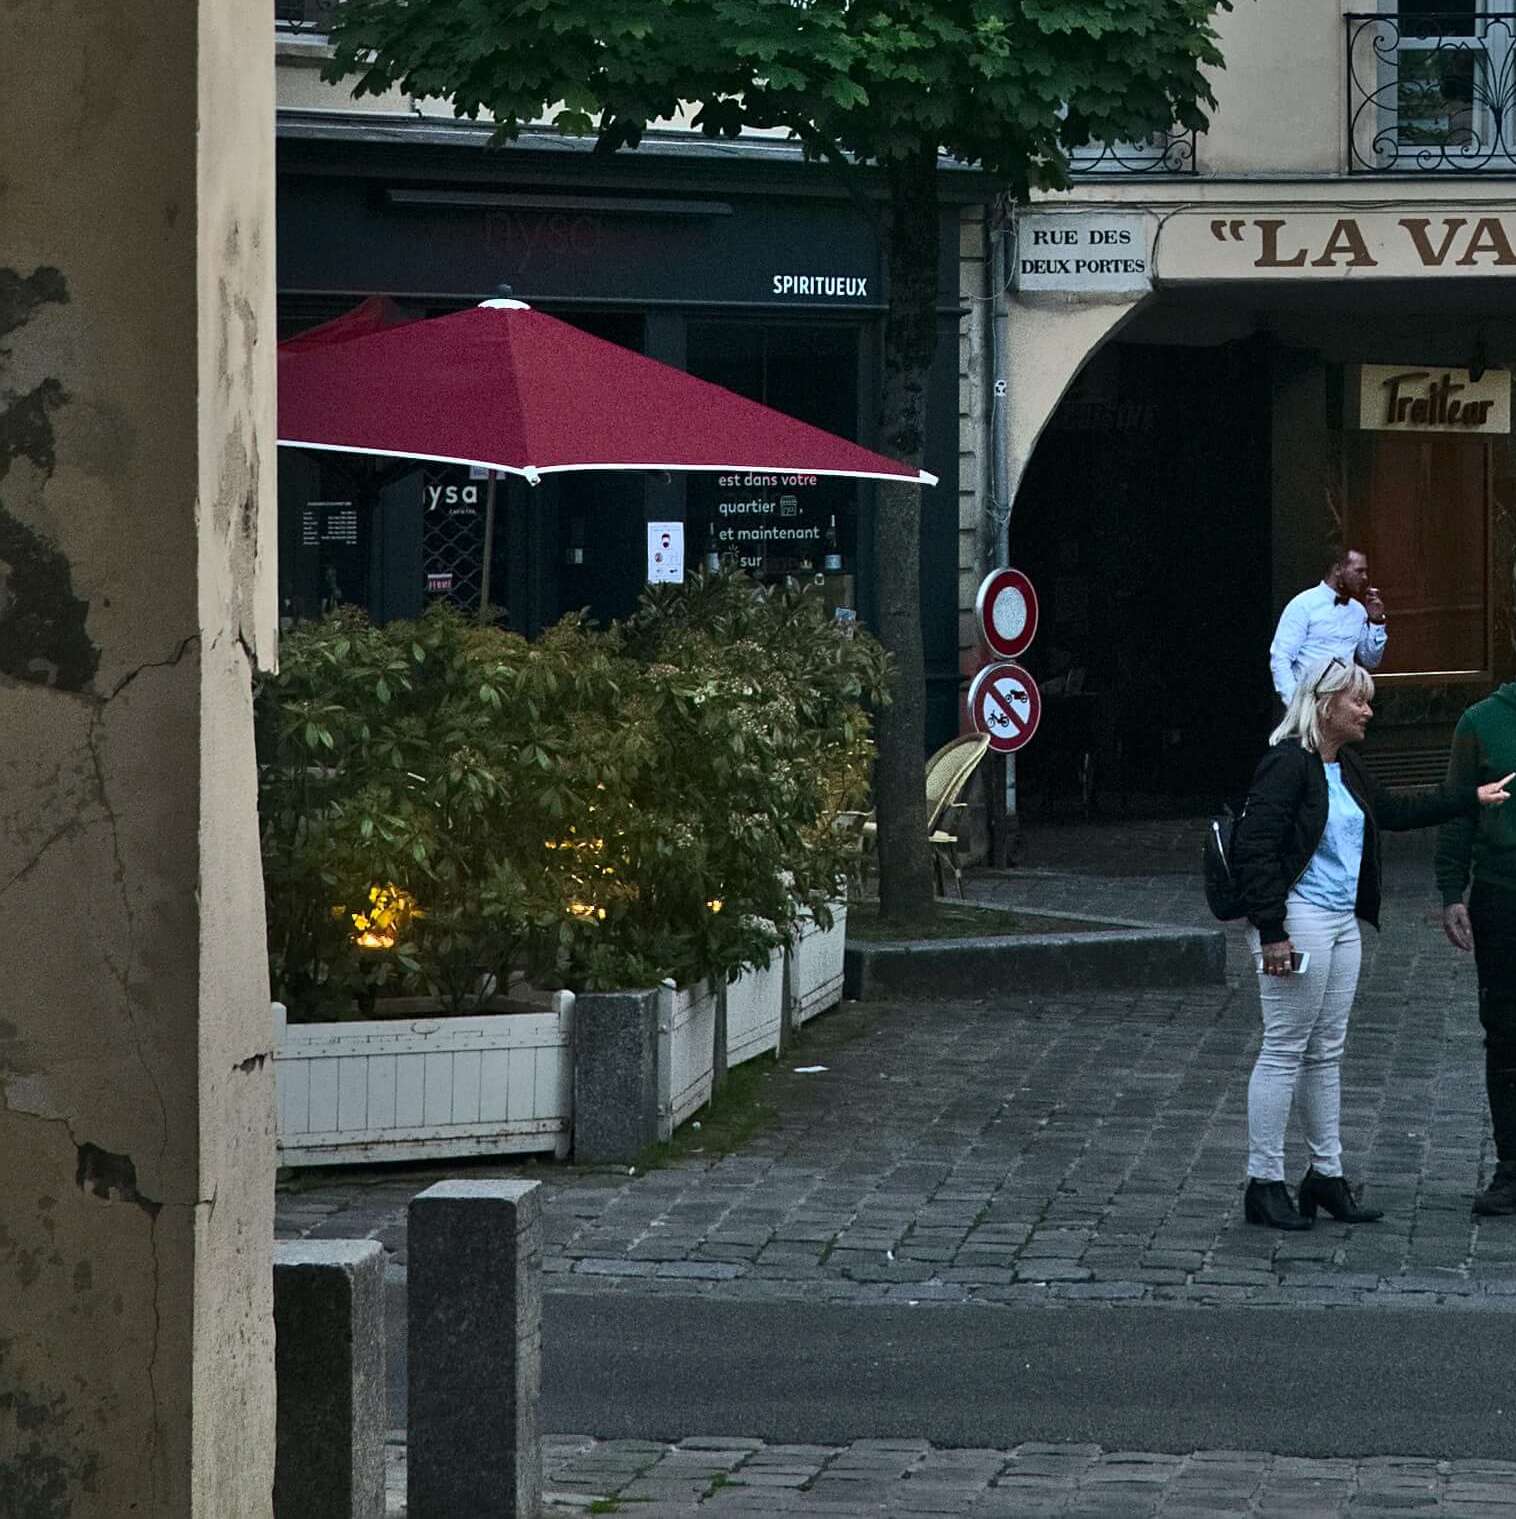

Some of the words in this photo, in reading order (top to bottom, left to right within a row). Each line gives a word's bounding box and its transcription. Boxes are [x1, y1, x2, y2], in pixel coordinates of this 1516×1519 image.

[1033, 229, 1079, 245] RUE
[1088, 229, 1132, 245] DES
[1020, 258, 1071, 275] DEUX
[1074, 258, 1146, 275] PORTES
[773, 275, 868, 297] SPIRITUEUX
[719, 473, 742, 487] est
[744, 473, 779, 487] dans
[781, 473, 818, 487] votre
[719, 498, 777, 518] quartier
[719, 526, 735, 541] et
[737, 525, 821, 541] maintenant
[740, 555, 763, 568] sur
